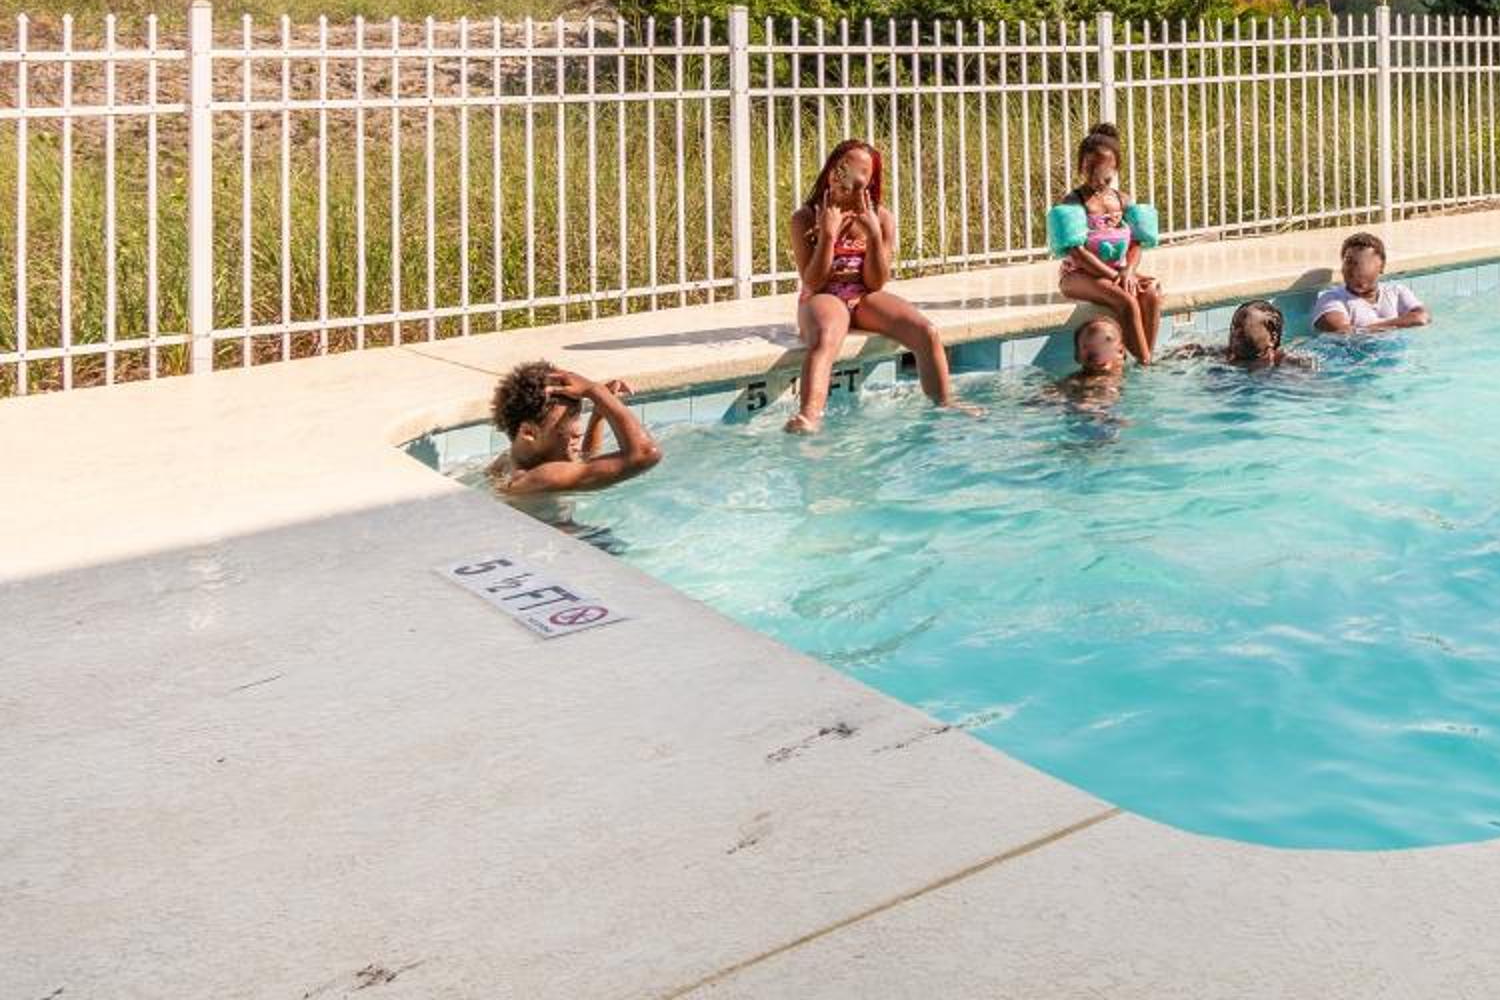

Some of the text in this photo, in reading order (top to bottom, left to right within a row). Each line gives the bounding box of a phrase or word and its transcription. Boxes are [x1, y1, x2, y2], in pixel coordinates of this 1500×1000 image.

[747, 382, 767, 410] 5
[829, 368, 860, 396] FT
[454, 559, 512, 575] 5
[502, 585, 580, 611] FT
